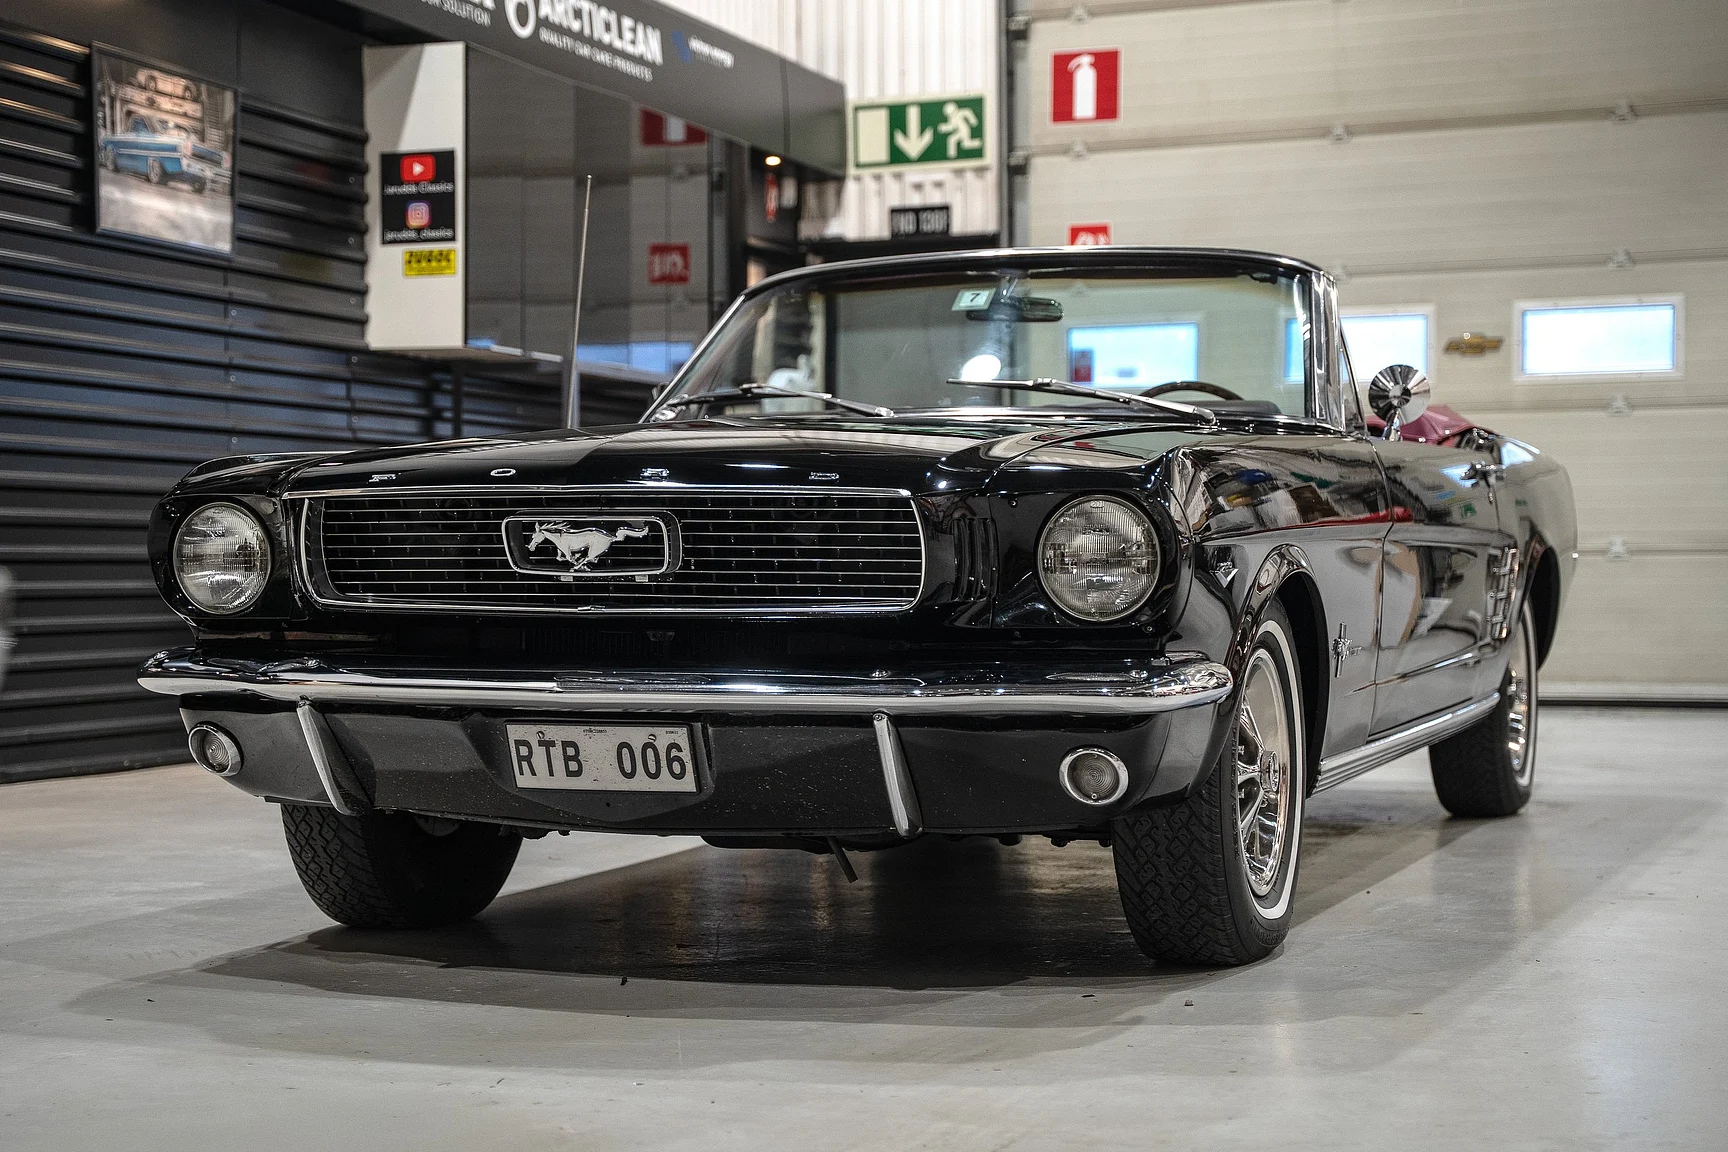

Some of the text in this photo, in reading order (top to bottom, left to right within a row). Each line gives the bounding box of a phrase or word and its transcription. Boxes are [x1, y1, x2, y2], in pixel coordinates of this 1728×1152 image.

[538, 0, 663, 66] ARCTICLEAN
[514, 739, 687, 780] RTB 006
